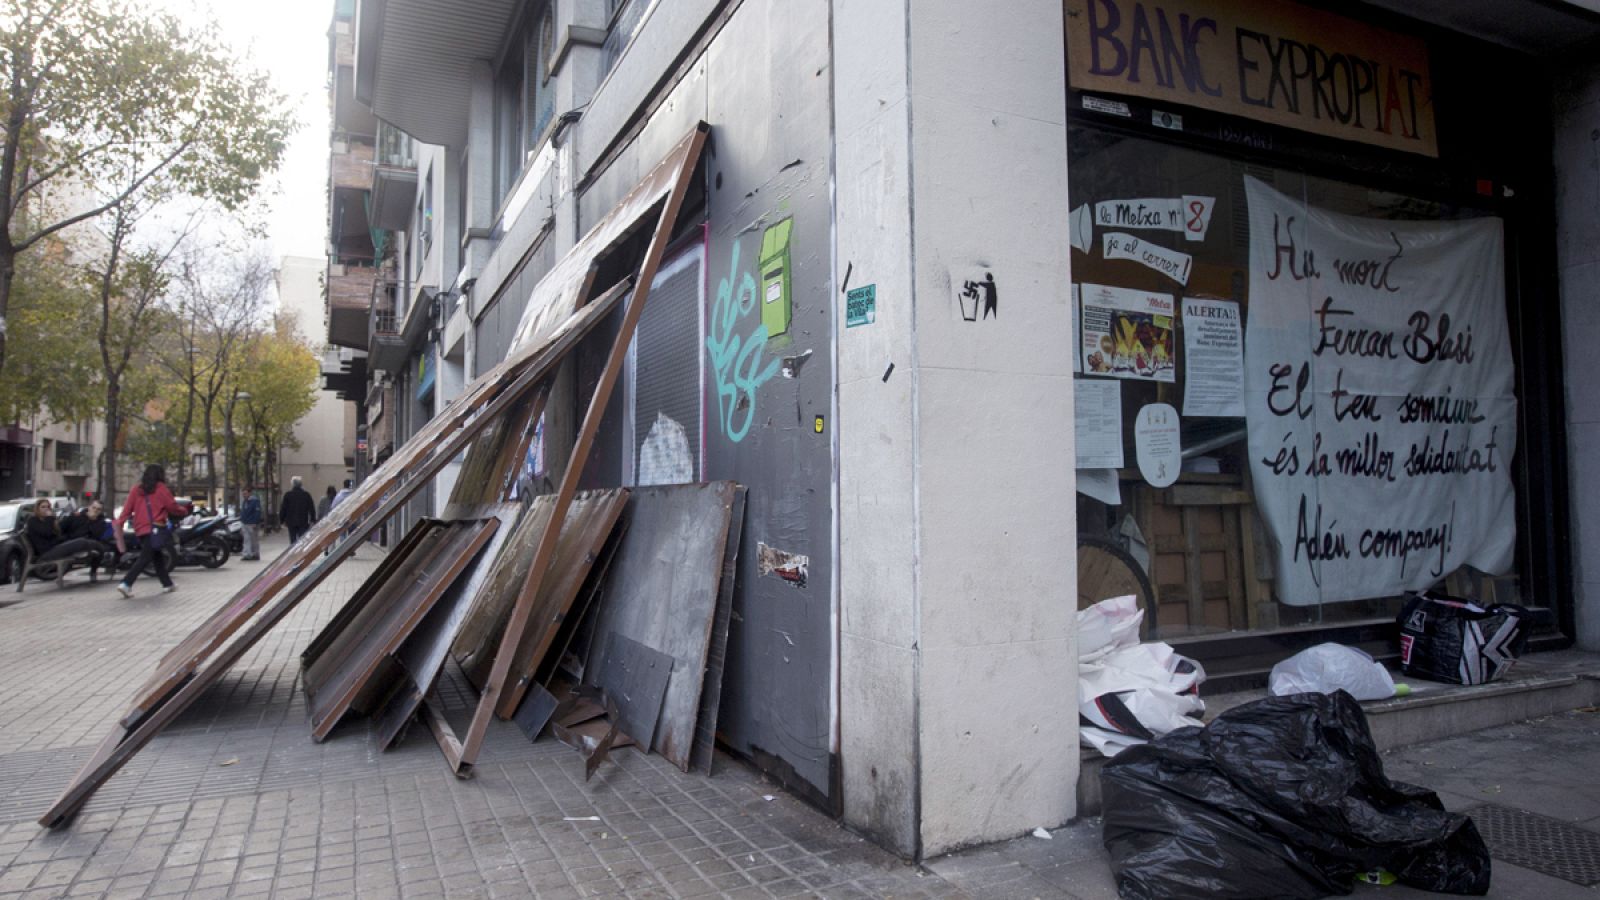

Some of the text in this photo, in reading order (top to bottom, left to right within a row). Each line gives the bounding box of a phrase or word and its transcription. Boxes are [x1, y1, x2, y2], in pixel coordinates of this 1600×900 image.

[1088, 0, 1421, 140] BANC EXPROPIAT
[1116, 203, 1161, 225] Metxa
[1187, 200, 1205, 233] 8
[1333, 231, 1404, 293] mort
[1313, 296, 1399, 358] Ferran
[1267, 361, 1314, 420] El
[1336, 432, 1396, 482] millor
